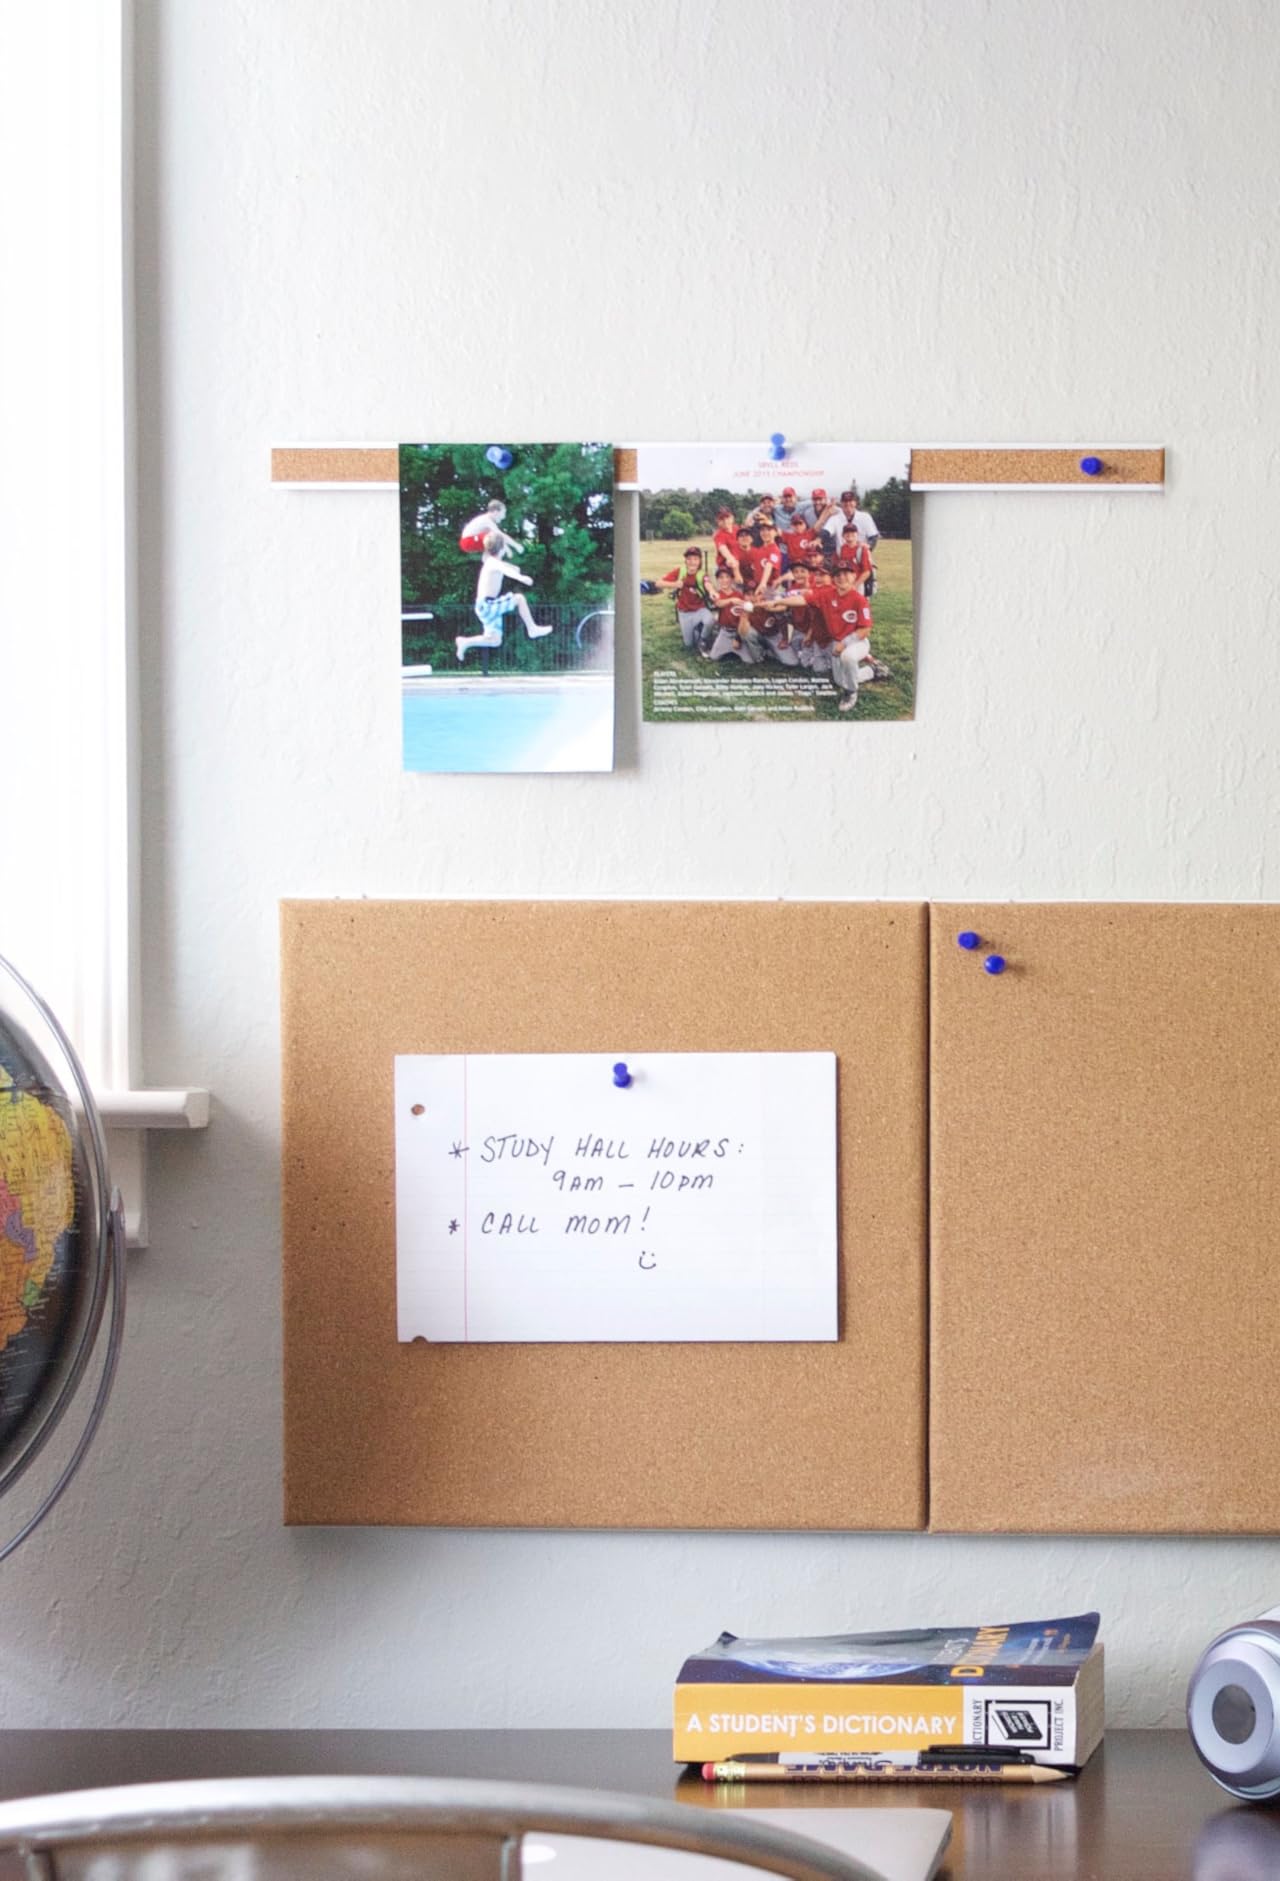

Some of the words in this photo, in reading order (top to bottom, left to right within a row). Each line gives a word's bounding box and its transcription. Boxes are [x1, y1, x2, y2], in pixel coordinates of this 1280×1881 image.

[480, 1134, 555, 1165] STUDY
[575, 1134, 630, 1160] HALL
[647, 1137, 744, 1159] HOURS:
[552, 1170, 604, 1192] 9AM
[650, 1171, 714, 1191] 10PM
[481, 1212, 539, 1235] CALL
[565, 1206, 651, 1235] MOM!
[1054, 1698, 1064, 1714] INC.
[687, 1713, 702, 1732] A
[709, 1713, 816, 1738] STUDENT'S
[823, 1714, 957, 1735] DICTIONARY
[973, 1699, 982, 1744] ICTIONARY
[1054, 1717, 1064, 1751] PROJECT
